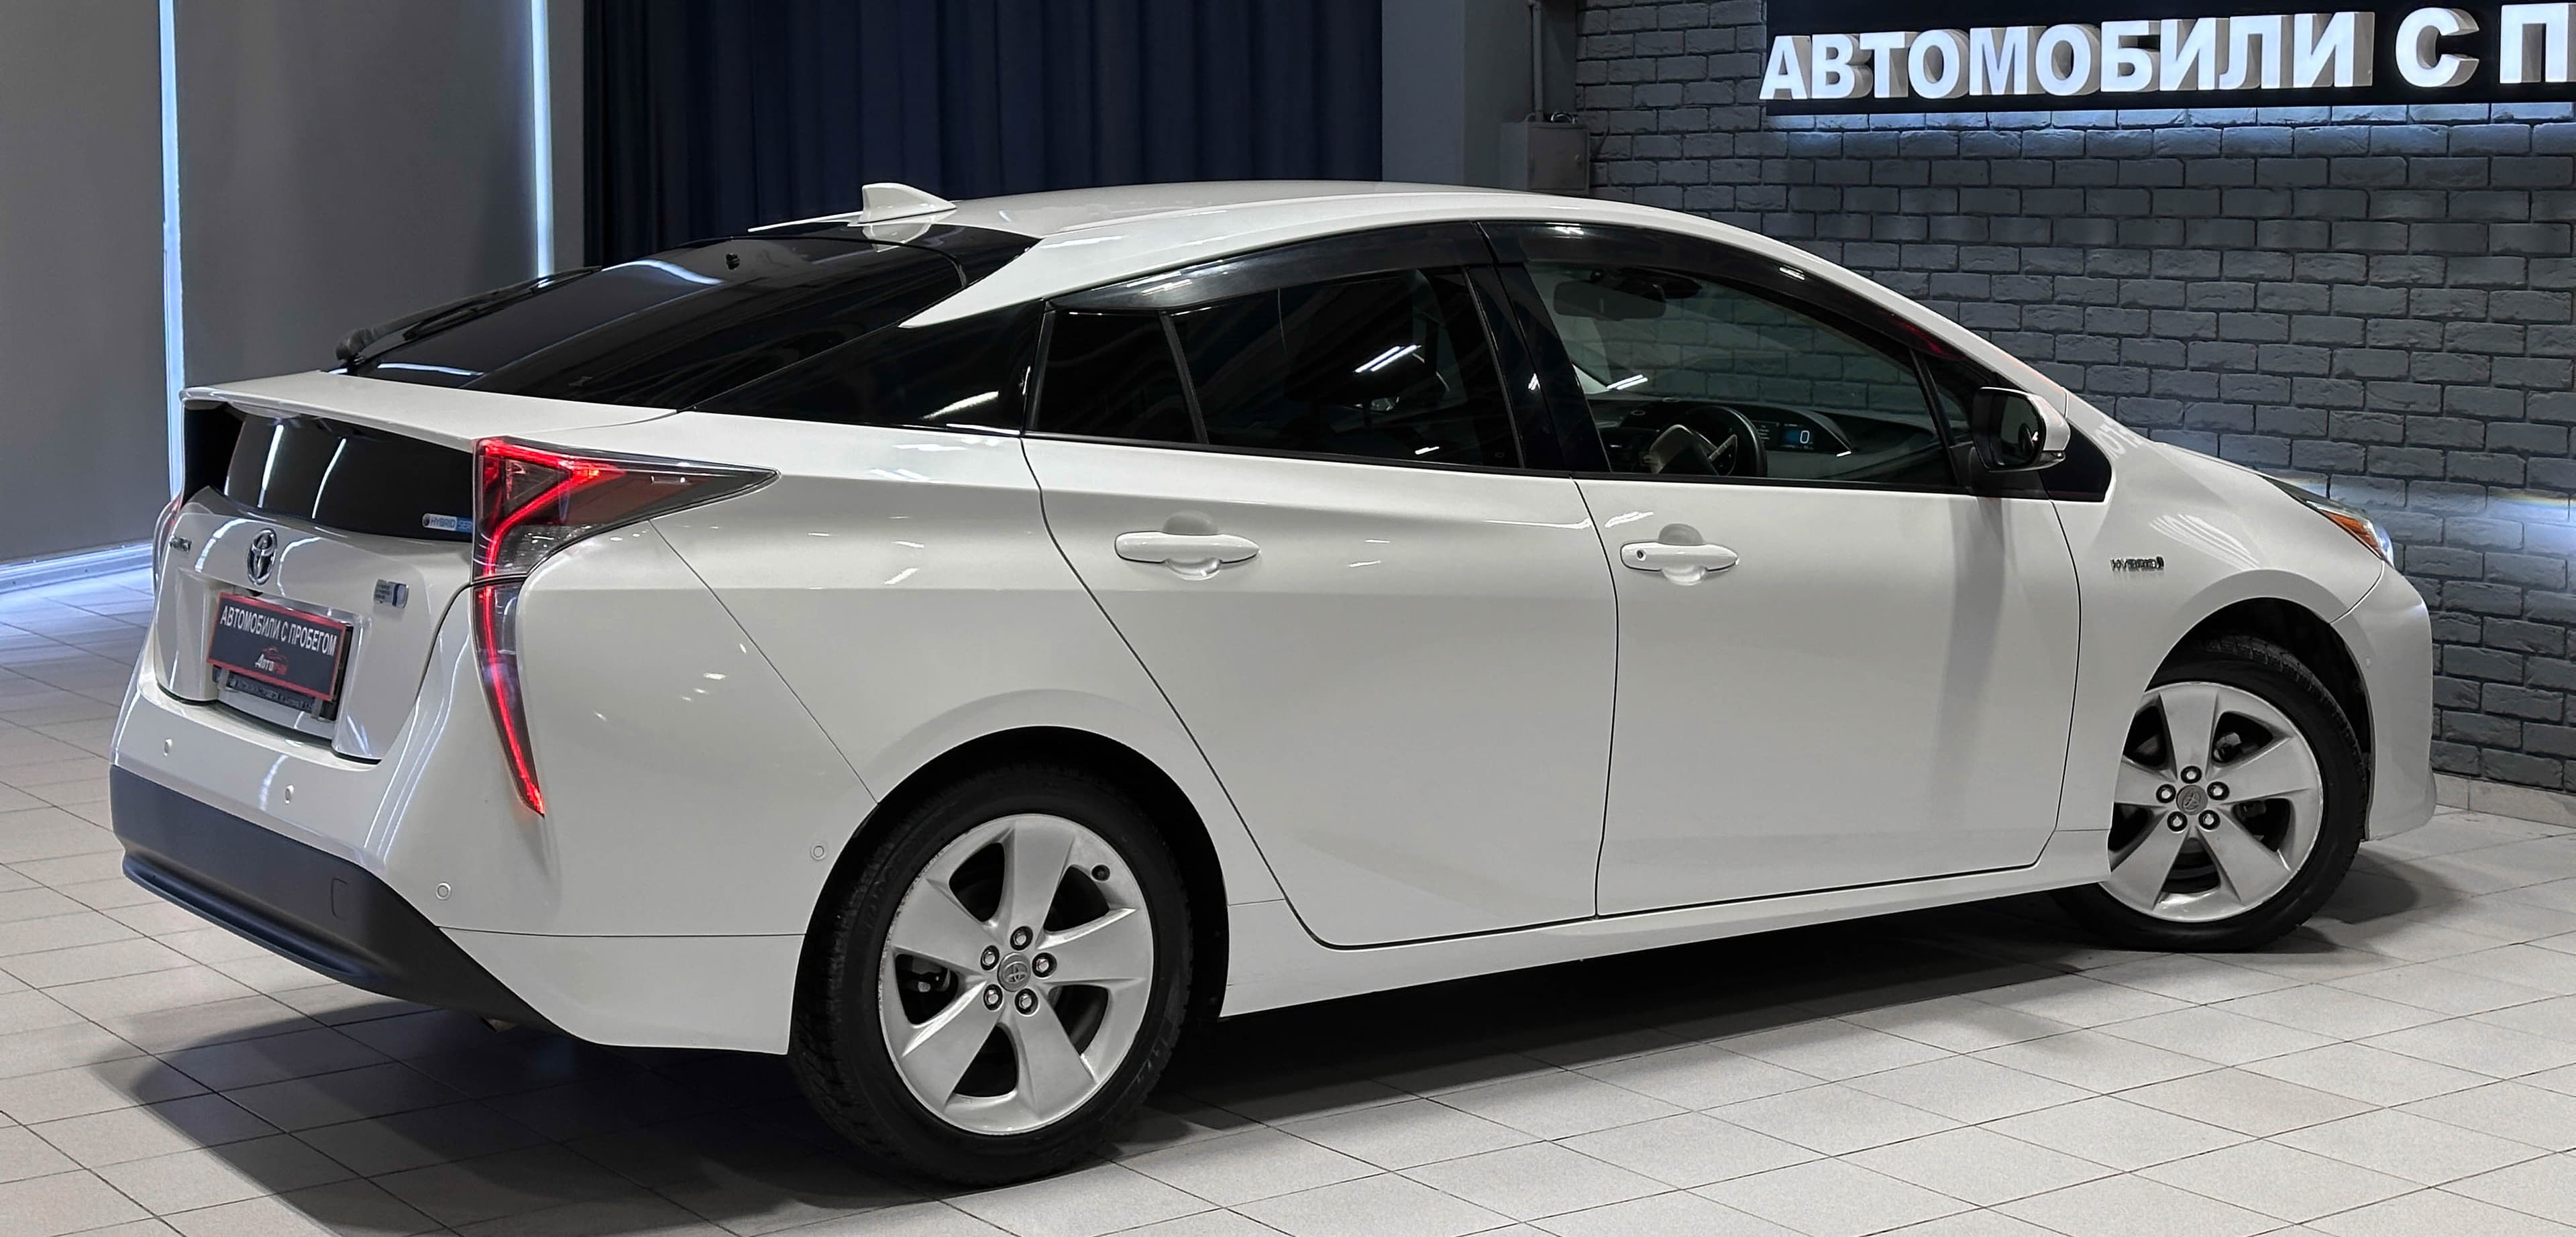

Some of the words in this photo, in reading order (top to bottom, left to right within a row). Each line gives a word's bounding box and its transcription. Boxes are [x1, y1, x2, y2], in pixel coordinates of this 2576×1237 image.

[1759, 12, 2374, 100] АВТОМОБИЛИ
[2396, 7, 2479, 88] С
[1800, 430, 1810, 443] 0
[220, 606, 280, 639] АВТОМОБИЛИ
[280, 621, 288, 642] С
[288, 624, 337, 656] ПРОБЕГОМ
